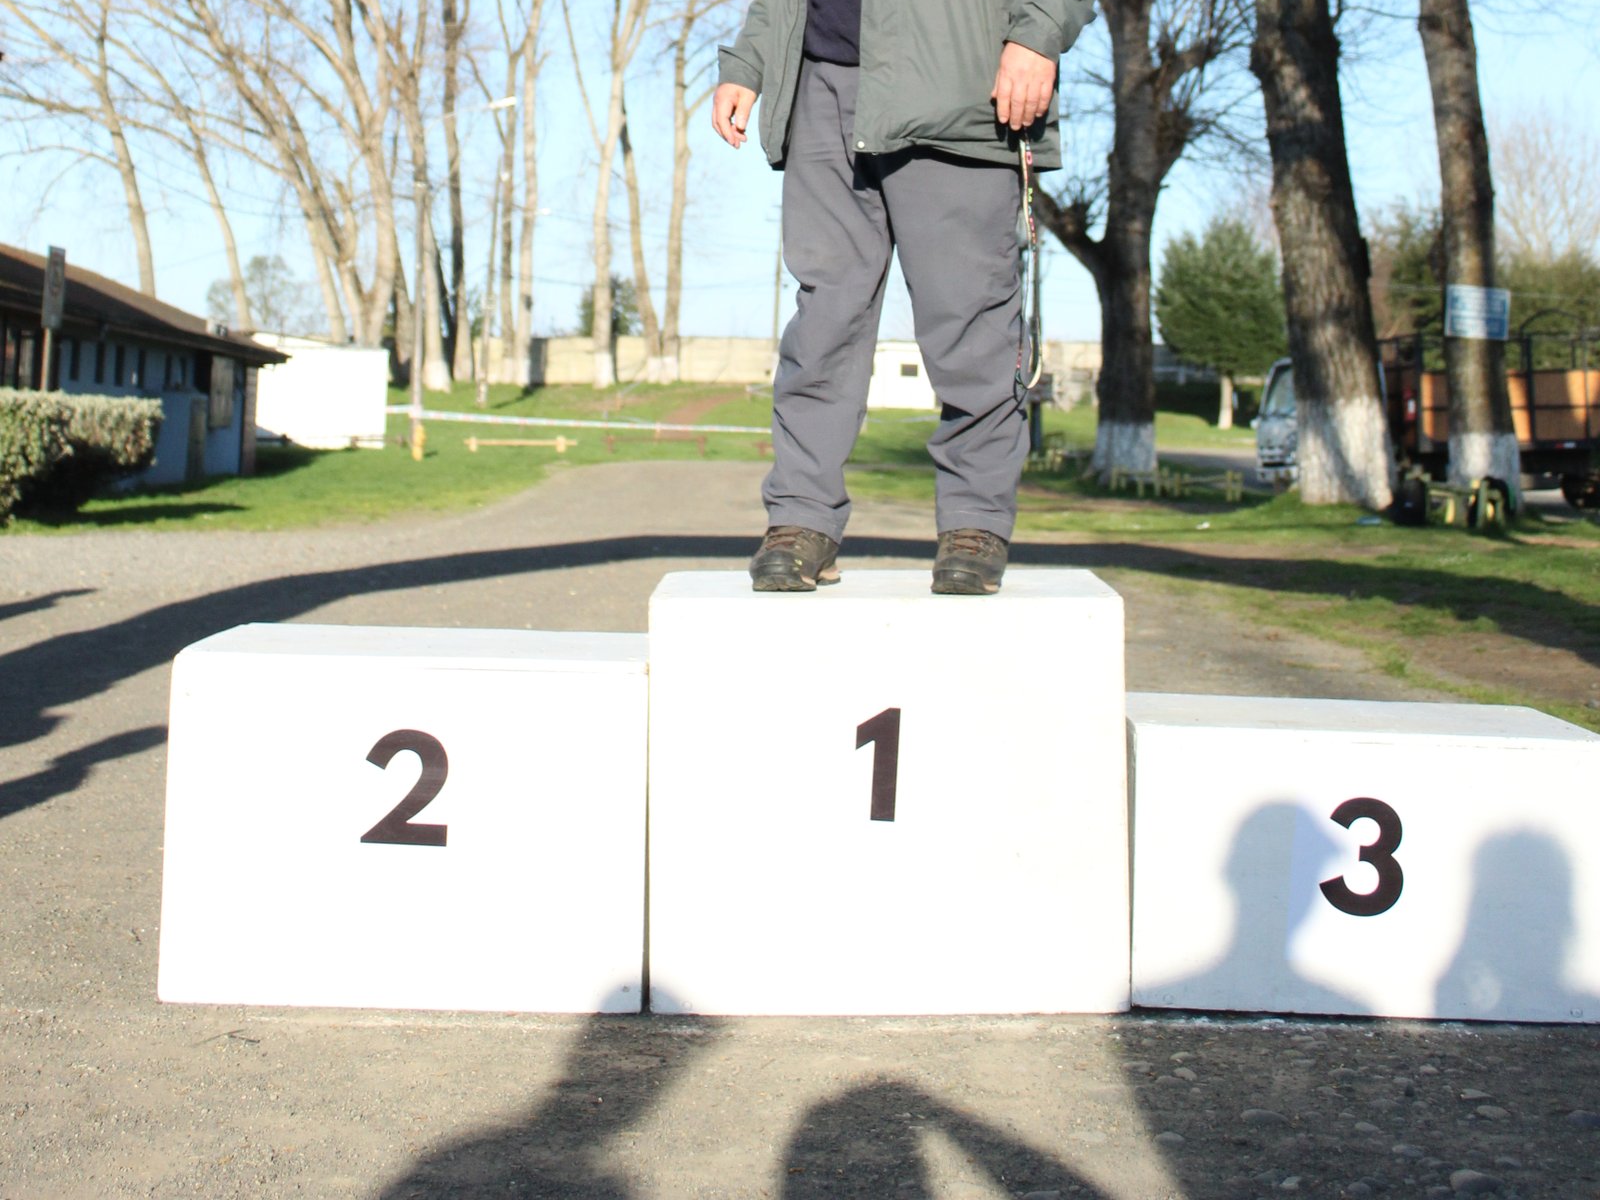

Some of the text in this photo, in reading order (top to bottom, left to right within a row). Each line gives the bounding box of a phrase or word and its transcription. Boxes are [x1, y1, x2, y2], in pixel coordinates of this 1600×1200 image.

[360, 729, 448, 847] 2
[856, 708, 901, 822] 1
[1319, 797, 1404, 917] 3
